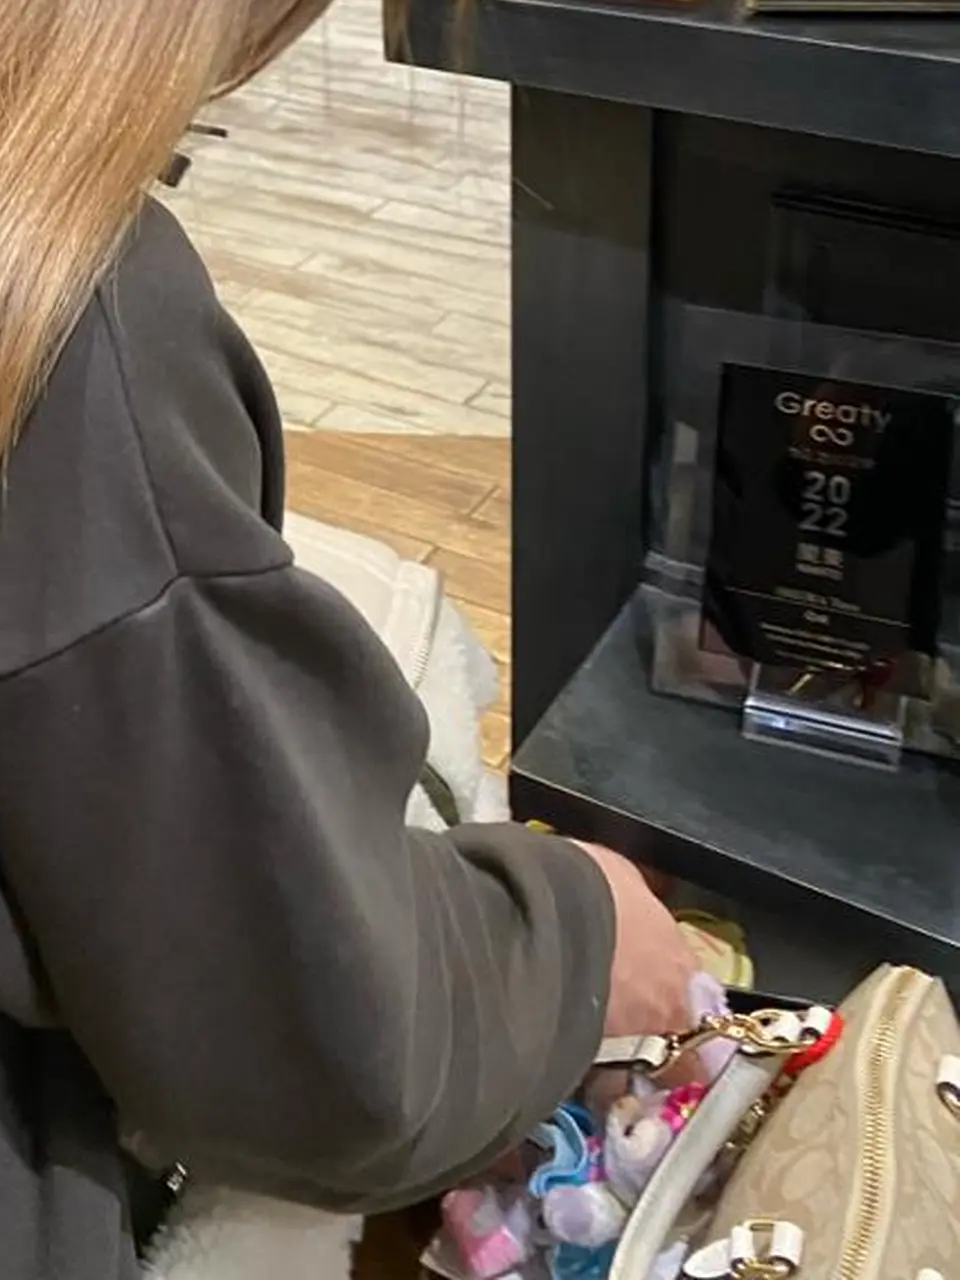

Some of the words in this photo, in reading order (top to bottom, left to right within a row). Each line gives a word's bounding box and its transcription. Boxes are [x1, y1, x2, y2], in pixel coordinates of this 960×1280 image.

[774, 391, 892, 434] Greaty
[802, 470, 851, 505] 20
[798, 501, 849, 537] 22
